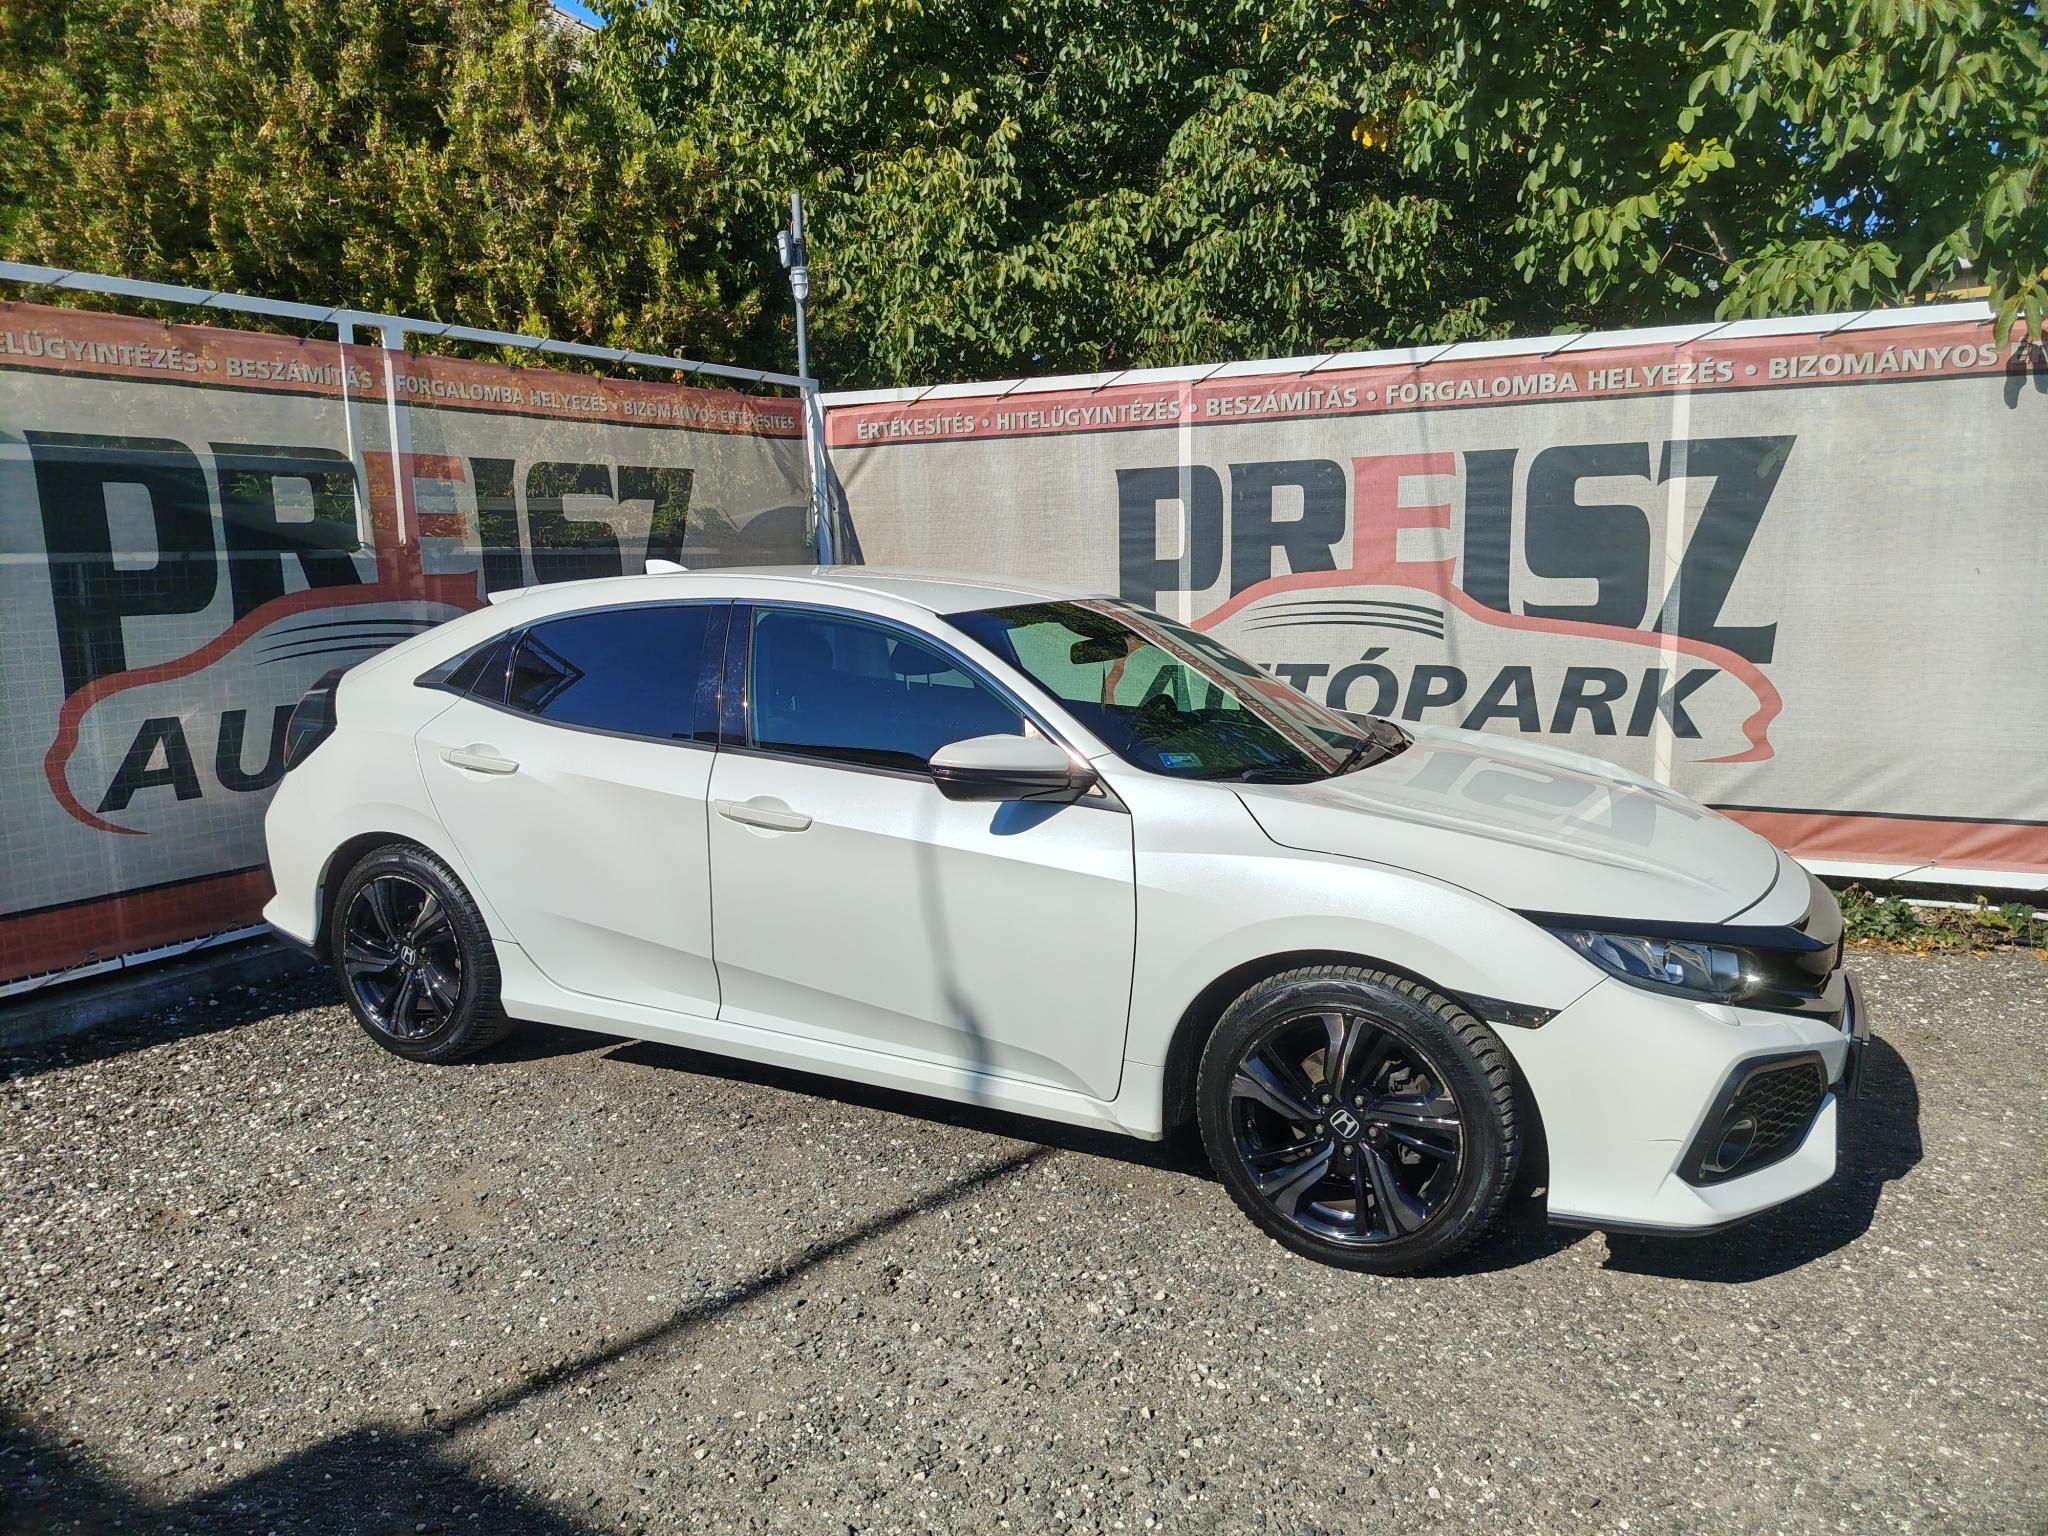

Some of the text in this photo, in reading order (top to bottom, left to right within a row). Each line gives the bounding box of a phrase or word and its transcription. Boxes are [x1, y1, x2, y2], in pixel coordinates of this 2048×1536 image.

[226, 356, 373, 389] BESZÁMÍTÁS
[395, 374, 526, 405] FORGALOMBA
[529, 389, 608, 412] HELYEZÉS
[857, 412, 975, 439] ÉRTÉKESÍTÉS
[997, 398, 1181, 430] HITELÜGYINTÉZÉS
[1206, 386, 1358, 416] BESZÁMÍTÁS
[1386, 372, 1577, 405] FORGALOMBA
[1588, 357, 1734, 391] HELYEZÉS
[1768, 342, 1999, 381] BIZOMÁNYOS
[1116, 434, 1798, 664] PREISZ
